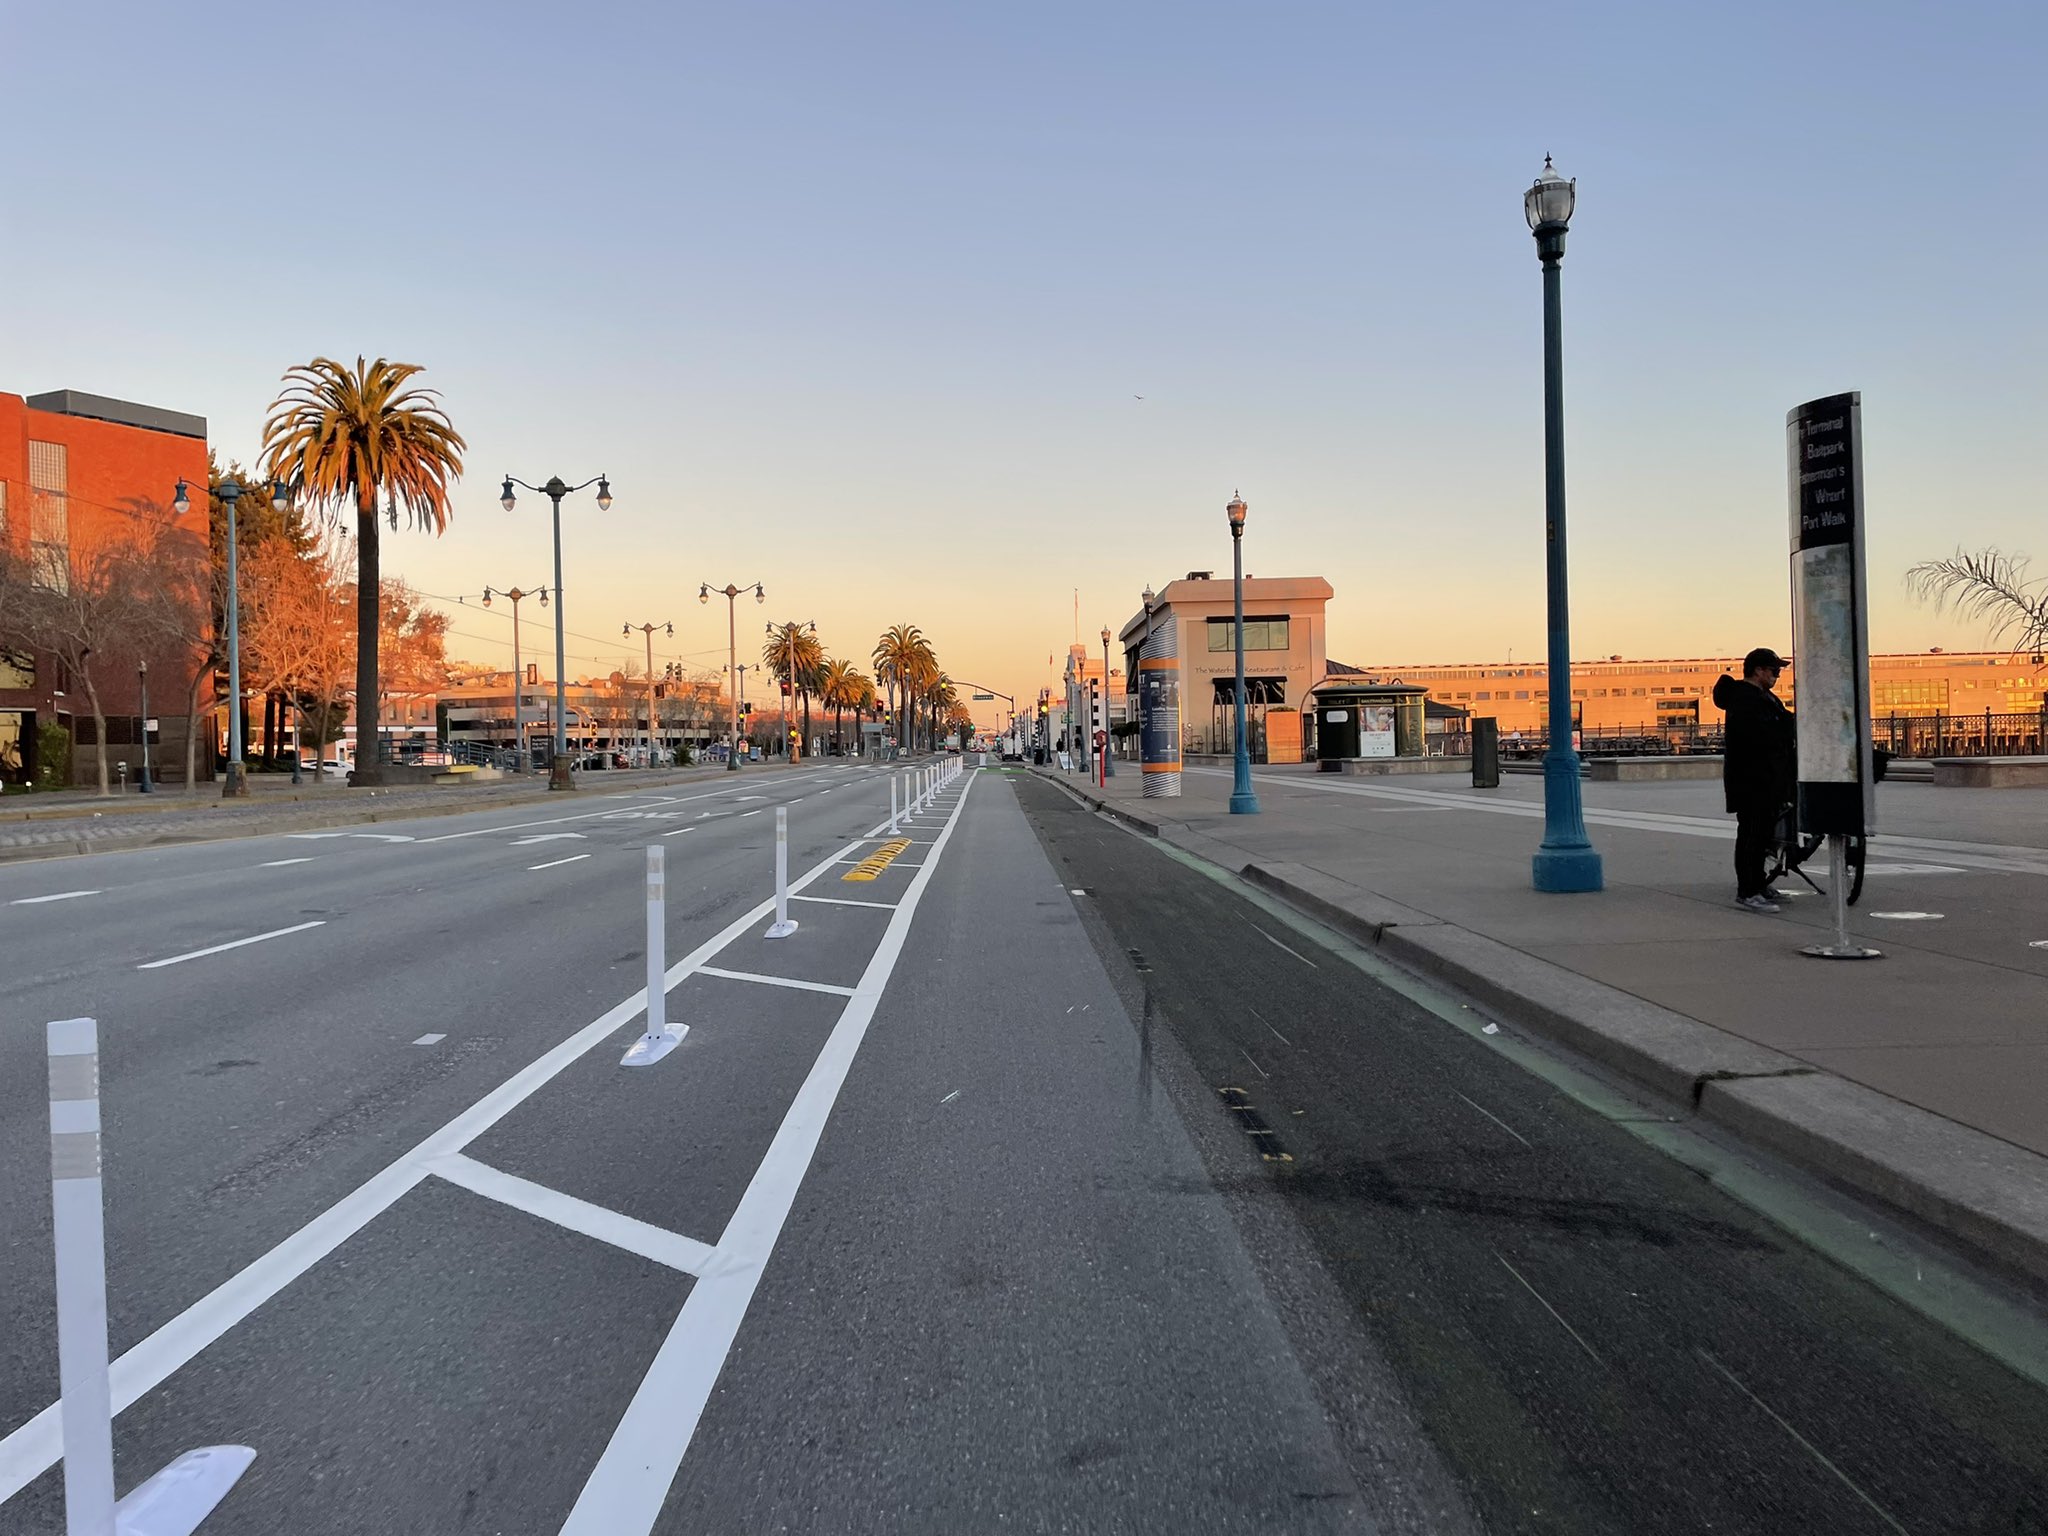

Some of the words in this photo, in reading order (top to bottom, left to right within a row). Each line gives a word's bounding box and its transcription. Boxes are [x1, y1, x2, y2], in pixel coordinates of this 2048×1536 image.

[1806, 415, 1844, 436] Terminal
[1807, 441, 1845, 459] Ballpark
[1800, 465, 1846, 485] sherman's
[1815, 487, 1846, 505] Wharf
[1803, 514, 1819, 531] Port
[1820, 510, 1846, 527] Walk
